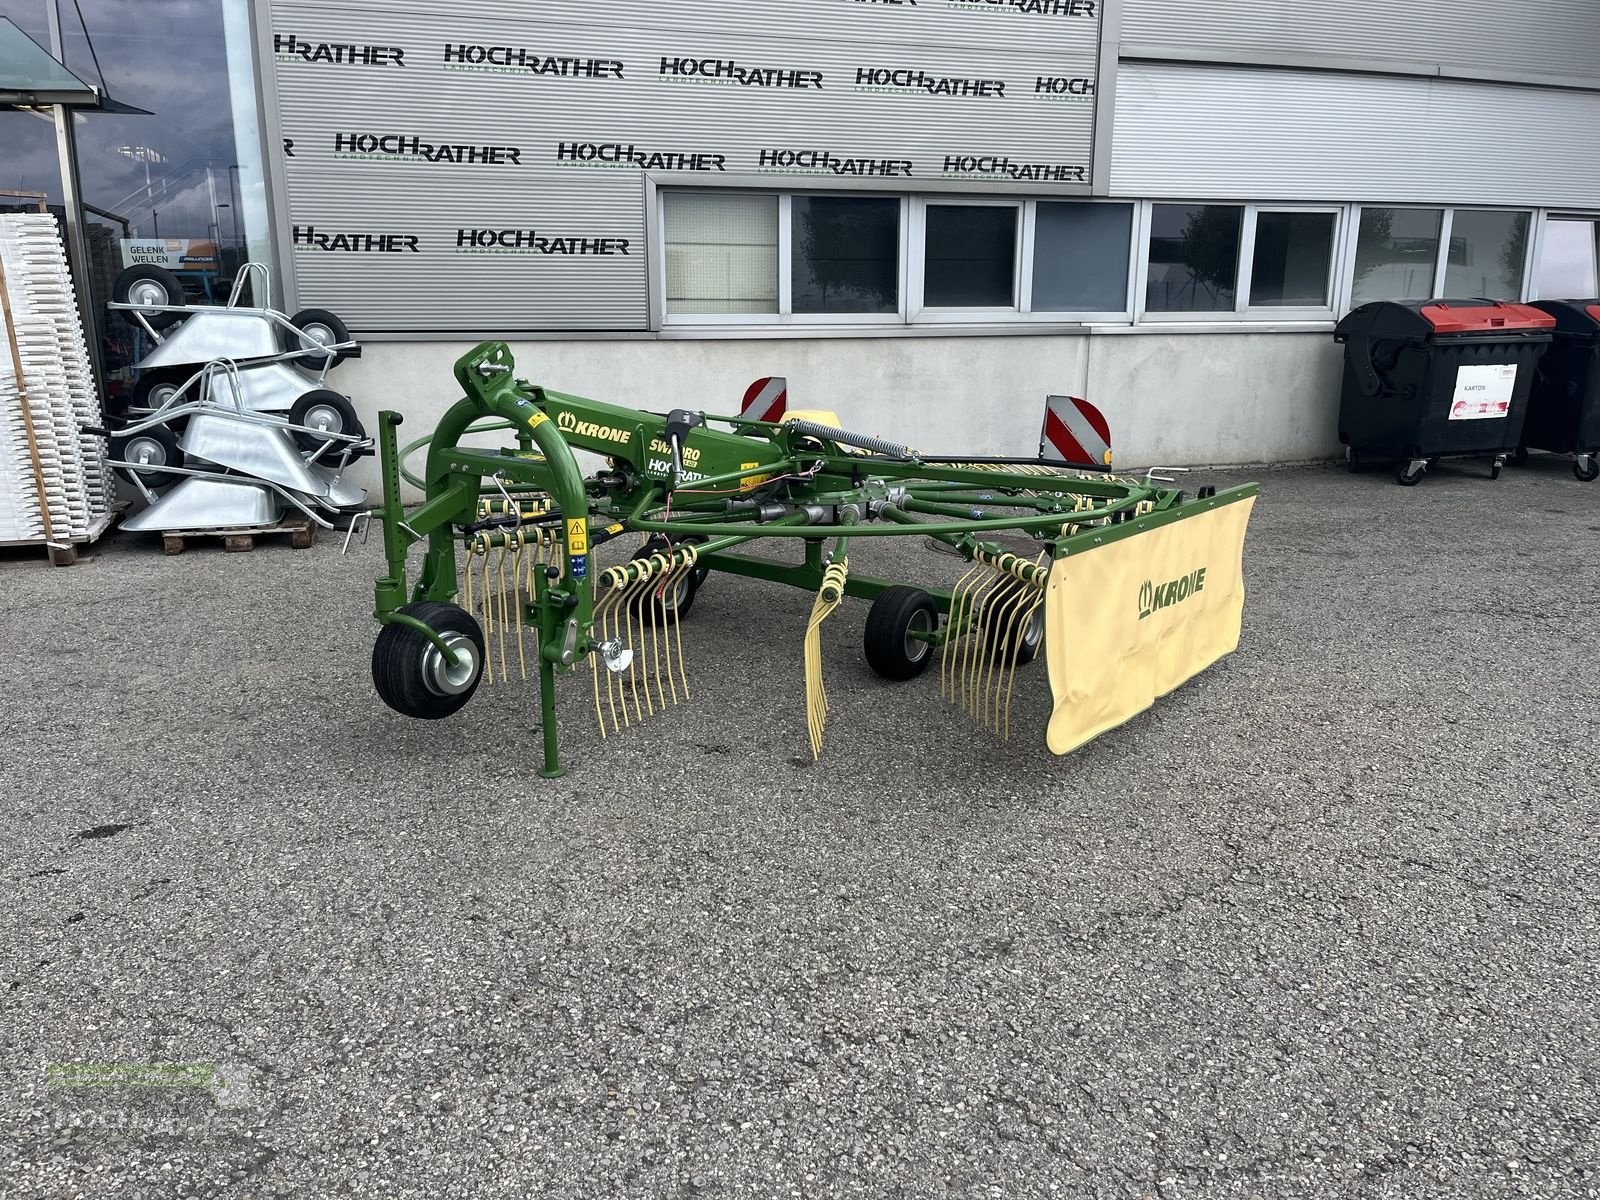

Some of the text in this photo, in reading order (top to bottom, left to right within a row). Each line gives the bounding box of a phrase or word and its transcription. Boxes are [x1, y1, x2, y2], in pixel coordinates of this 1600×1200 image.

[443, 64, 529, 74] LANDTECHNIK
[444, 44, 625, 80] HOCHRATHER
[659, 57, 824, 90] HOCHRATHER
[659, 76, 737, 86] LANDTECHNIK
[855, 68, 1006, 98] HOCHRATHER
[334, 154, 424, 162] LANDTECHNIK
[335, 133, 522, 165] HOCHRATHER
[557, 142, 726, 172] HOCHRATHER
[759, 149, 913, 176] HOCHRATHER
[943, 155, 1085, 181] HOCHRATHER
[130, 246, 165, 254] GELENK
[456, 229, 630, 255] HOCHRATHER
[131, 255, 169, 263] WELLEN
[575, 421, 631, 444] KRONE
[1152, 567, 1207, 612] KRONE
